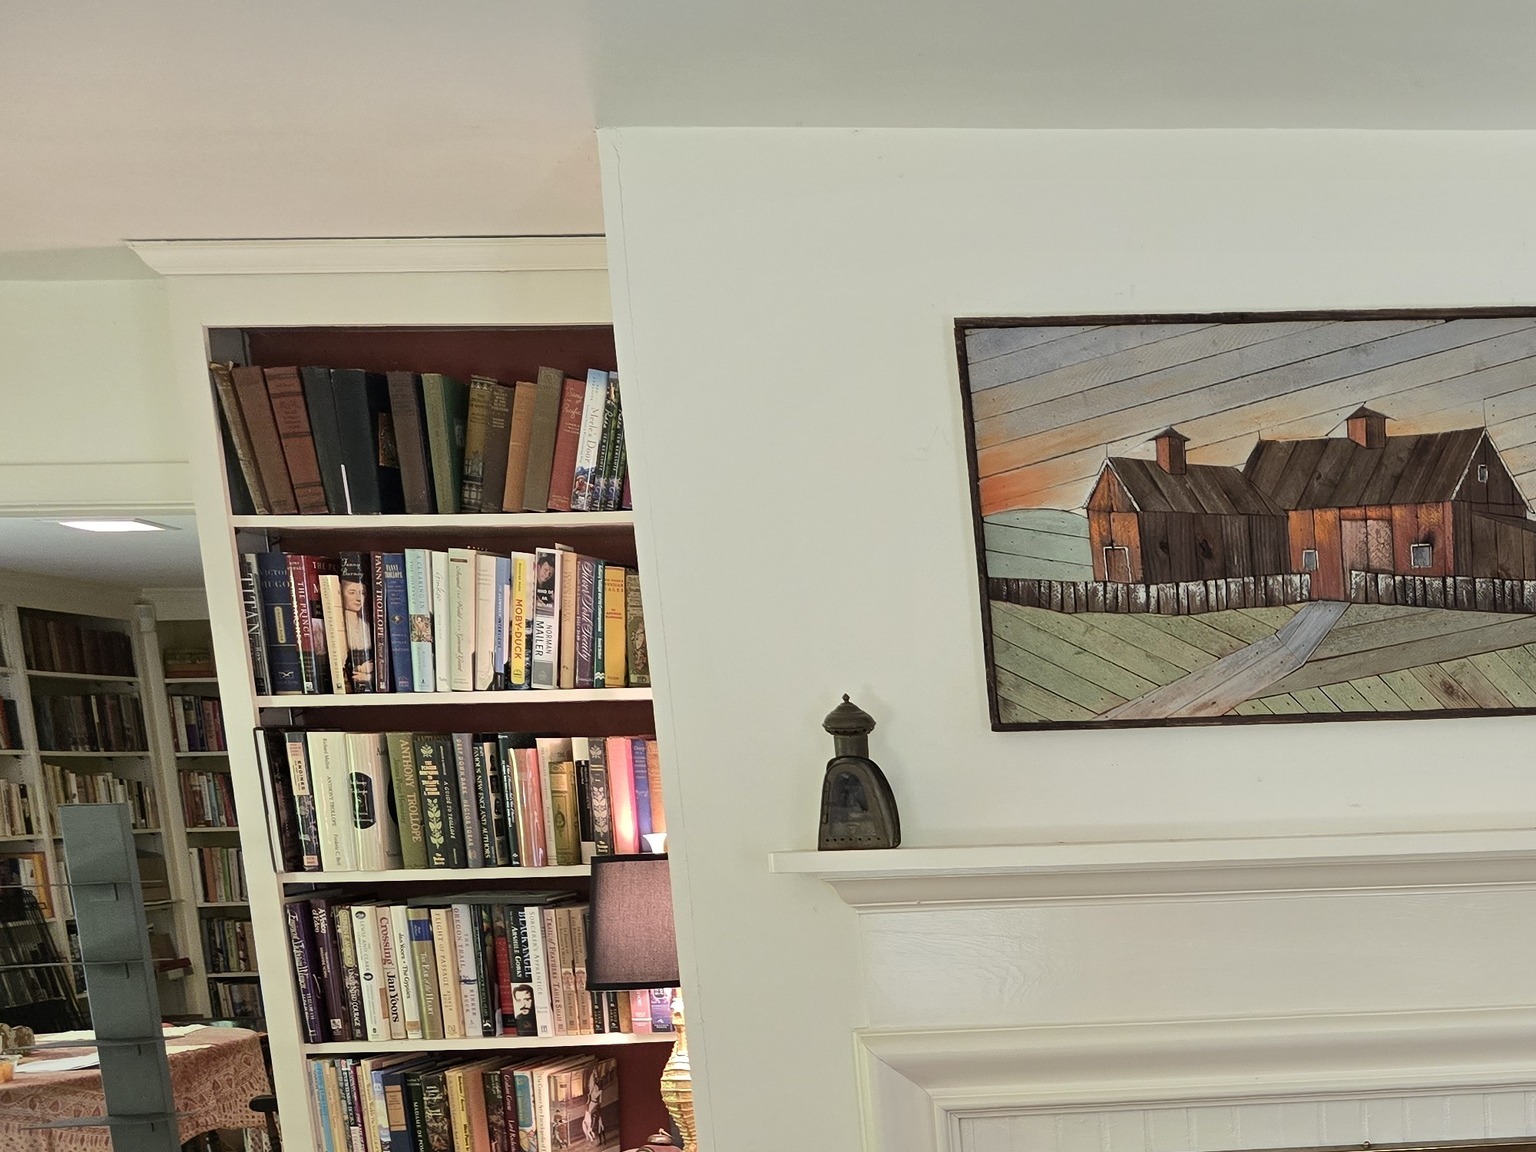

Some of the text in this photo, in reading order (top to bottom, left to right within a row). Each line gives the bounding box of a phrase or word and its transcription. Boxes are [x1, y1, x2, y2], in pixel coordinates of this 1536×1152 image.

[585, 438, 597, 463] Door
[241, 572, 261, 636] TITAN
[297, 581, 310, 637] THE PRINCE
[374, 555, 384, 636] FANNY TROLLOPE
[514, 599, 523, 660] MOBY-DUCK
[535, 620, 544, 657] MAILER
[545, 624, 553, 655] NORMAN
[457, 756, 465, 777] DOWN
[473, 746, 482, 773] FAMOUS
[399, 739, 423, 843] ANTHONY TROLLOPE
[460, 778, 468, 794] DARK
[448, 813, 456, 839] TROLLOPE
[479, 792, 487, 826] ENGLAND
[482, 827, 491, 859] AUTHORS
[435, 913, 443, 942] FLIGHT
[440, 953, 449, 986] PASSAGE
[454, 908, 466, 970] OREGON TRAIL
[511, 926, 522, 978] ARSHILE GORKY
[518, 911, 533, 977] BLACK ANGEL
[528, 911, 543, 995] SORCERER'S APPRENTICE
[545, 917, 553, 937] TRAIL
[550, 947, 558, 980] FEATHERS
[380, 916, 399, 1023] Crossing Jan Yoors
[403, 976, 411, 999] Gypsies
[469, 989, 477, 1016] RINKER
[350, 1001, 360, 1027] COURAGE
[502, 1074, 510, 1093] Graham
[413, 1101, 421, 1129] MADAME
